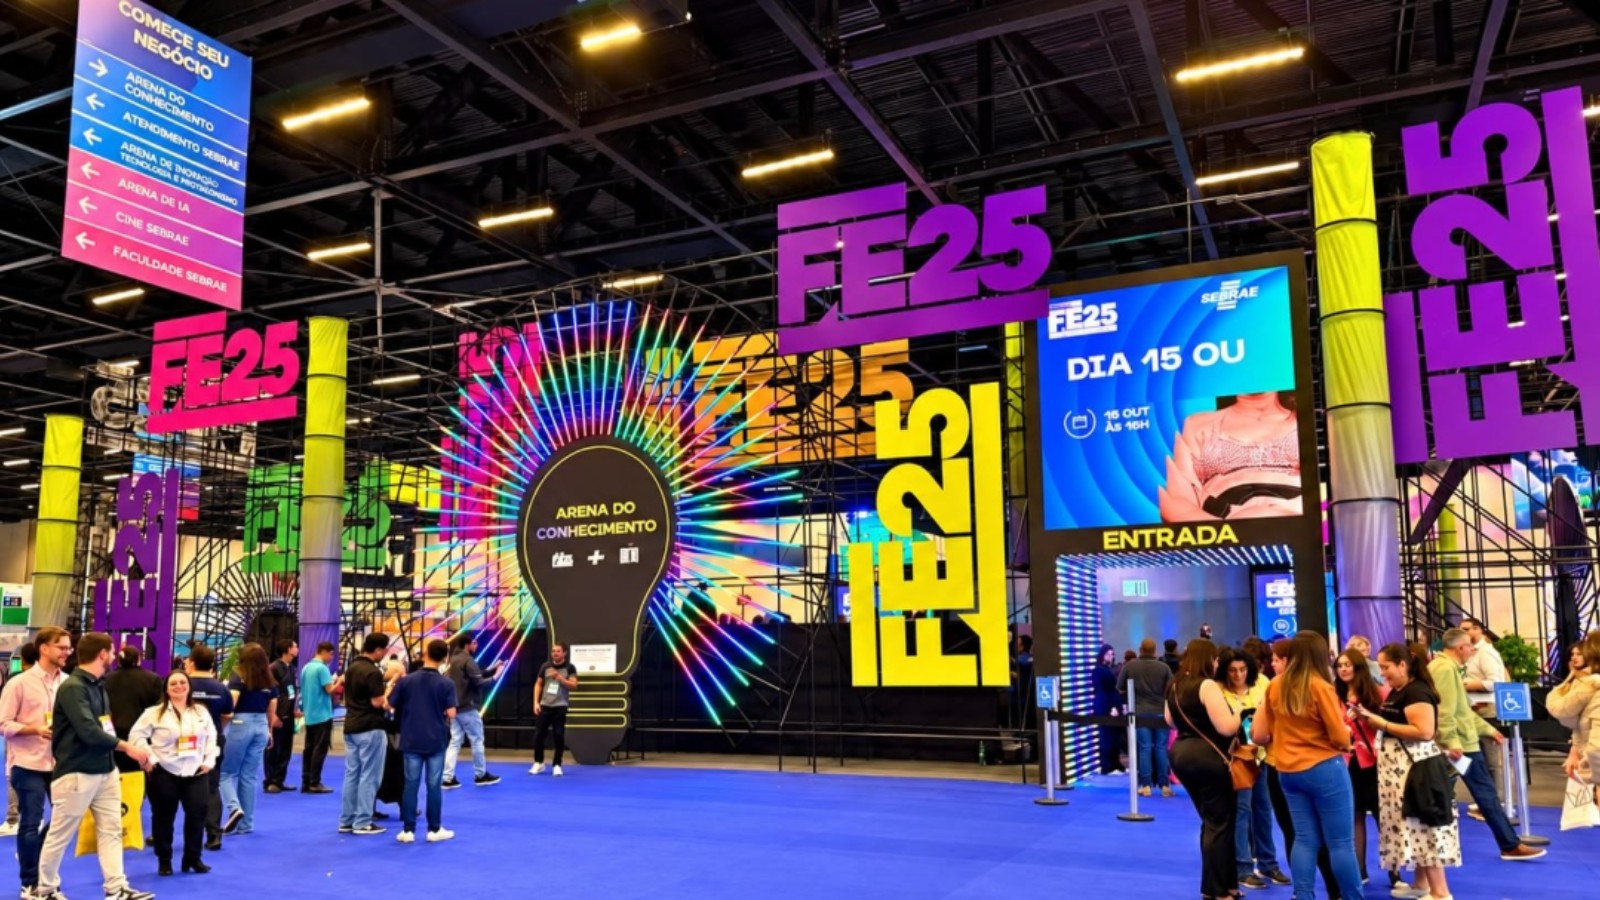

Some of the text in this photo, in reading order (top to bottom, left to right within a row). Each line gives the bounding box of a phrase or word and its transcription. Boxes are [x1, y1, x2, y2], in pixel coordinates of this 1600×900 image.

[119, 0, 230, 68] COMECE SEU
[134, 29, 213, 80] NEGÓCIO
[124, 83, 215, 132] CONHECIMENTO
[126, 72, 186, 106] ARENA DO
[120, 141, 158, 164] ARENA
[159, 157, 174, 171] DE
[123, 111, 240, 171] ATENDIMENTO SEBRAE
[118, 178, 191, 214] ARENA DE IA
[115, 211, 190, 246] CINE SEBRAE
[113, 245, 228, 292] FACULDADE SEBRAE
[778, 184, 1052, 325] FE25
[1201, 286, 1259, 304] SEBRAE
[1401, 101, 1578, 460] FE25
[1048, 301, 1118, 335] FE25
[148, 320, 300, 414] FE25
[1067, 338, 1246, 381] DIA 15 OU
[693, 338, 915, 448] FE25
[1122, 405, 1150, 419] OUT
[536, 519, 657, 540] CONHECIMENTO
[556, 501, 636, 520] ARENA DO
[873, 387, 979, 687] FE25
[1102, 524, 1239, 550] ENTRADA
